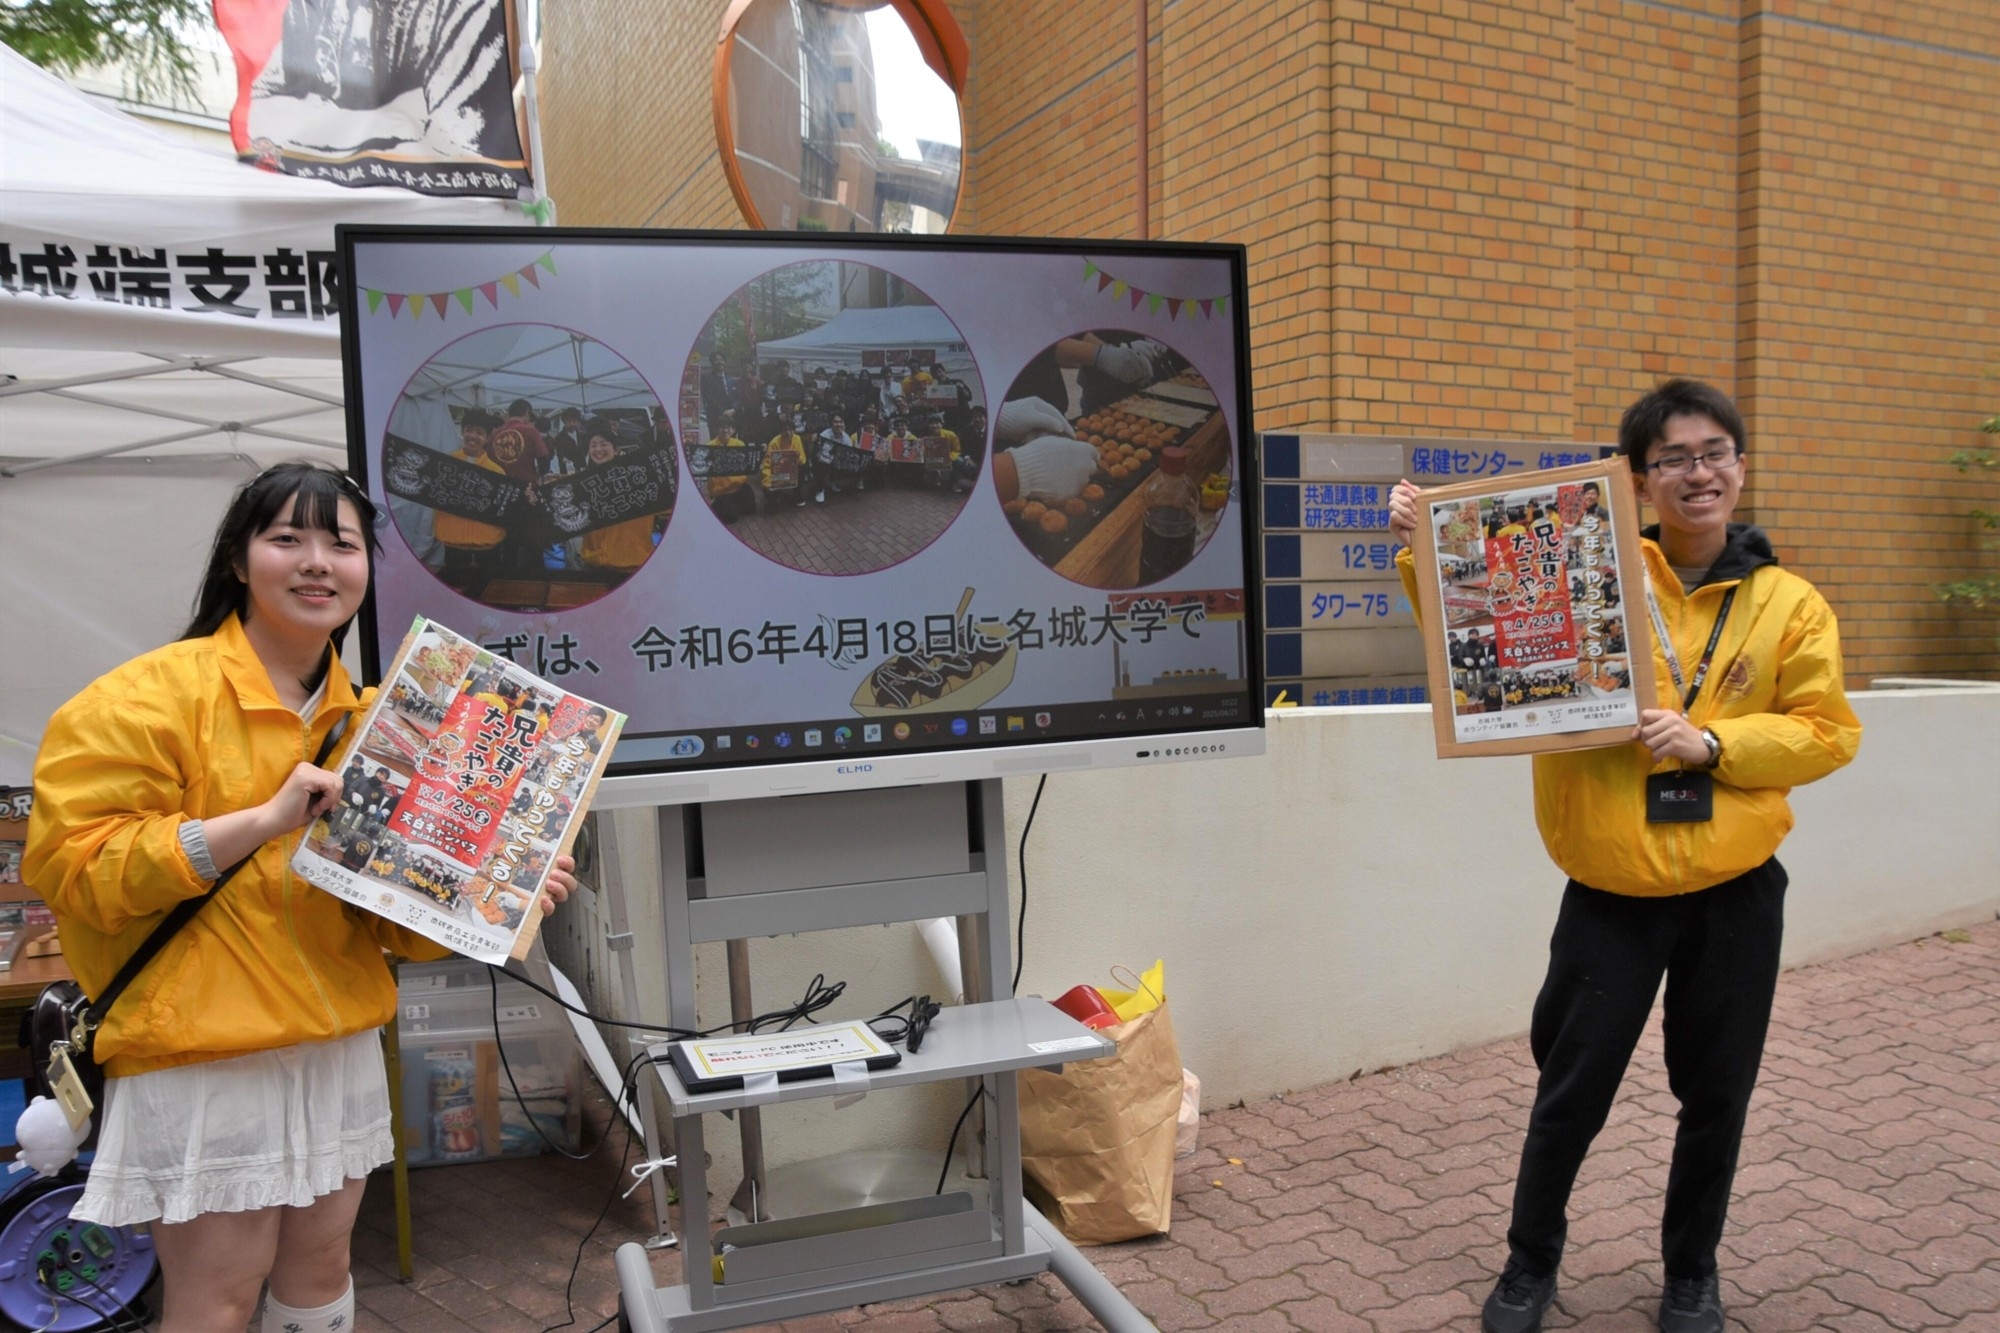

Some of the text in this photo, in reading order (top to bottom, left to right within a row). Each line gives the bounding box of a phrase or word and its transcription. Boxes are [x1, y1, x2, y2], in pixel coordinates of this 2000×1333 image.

[1411, 447, 1524, 475] 保健センター
[1305, 485, 1379, 505] 共通講義棟
[1342, 544, 1405, 570] 12号
[1311, 593, 1389, 619] タワー75
[631, 599, 1207, 673] 令和6年4月18日に名城大学で
[837, 765, 874, 774] ELMO
